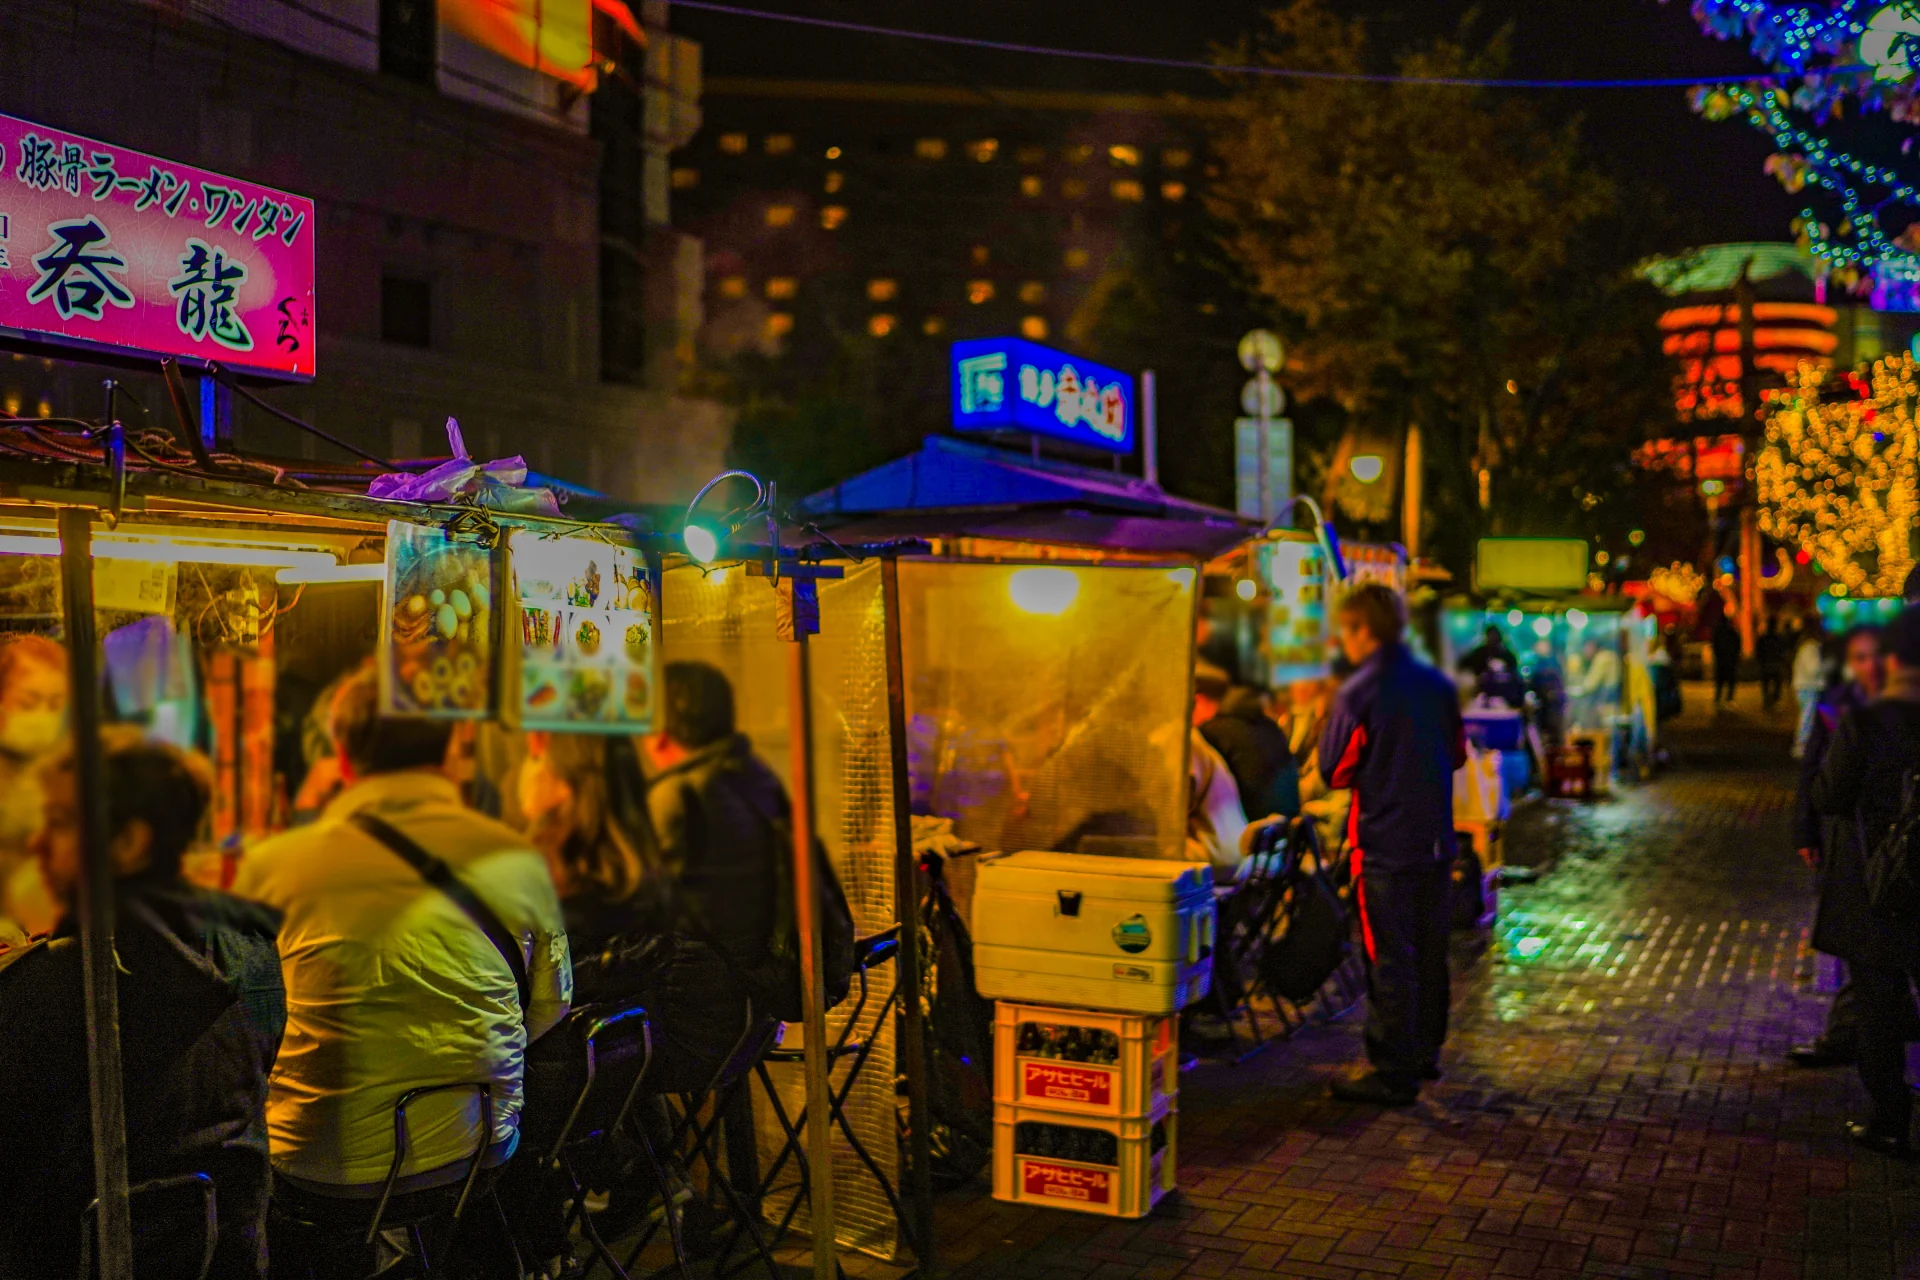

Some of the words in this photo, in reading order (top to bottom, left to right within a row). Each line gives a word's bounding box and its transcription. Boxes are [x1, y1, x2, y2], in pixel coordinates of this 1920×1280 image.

[19, 135, 305, 246] 豚骨ラーメン・ワンタン
[1026, 1066, 1108, 1089] アサヒビール
